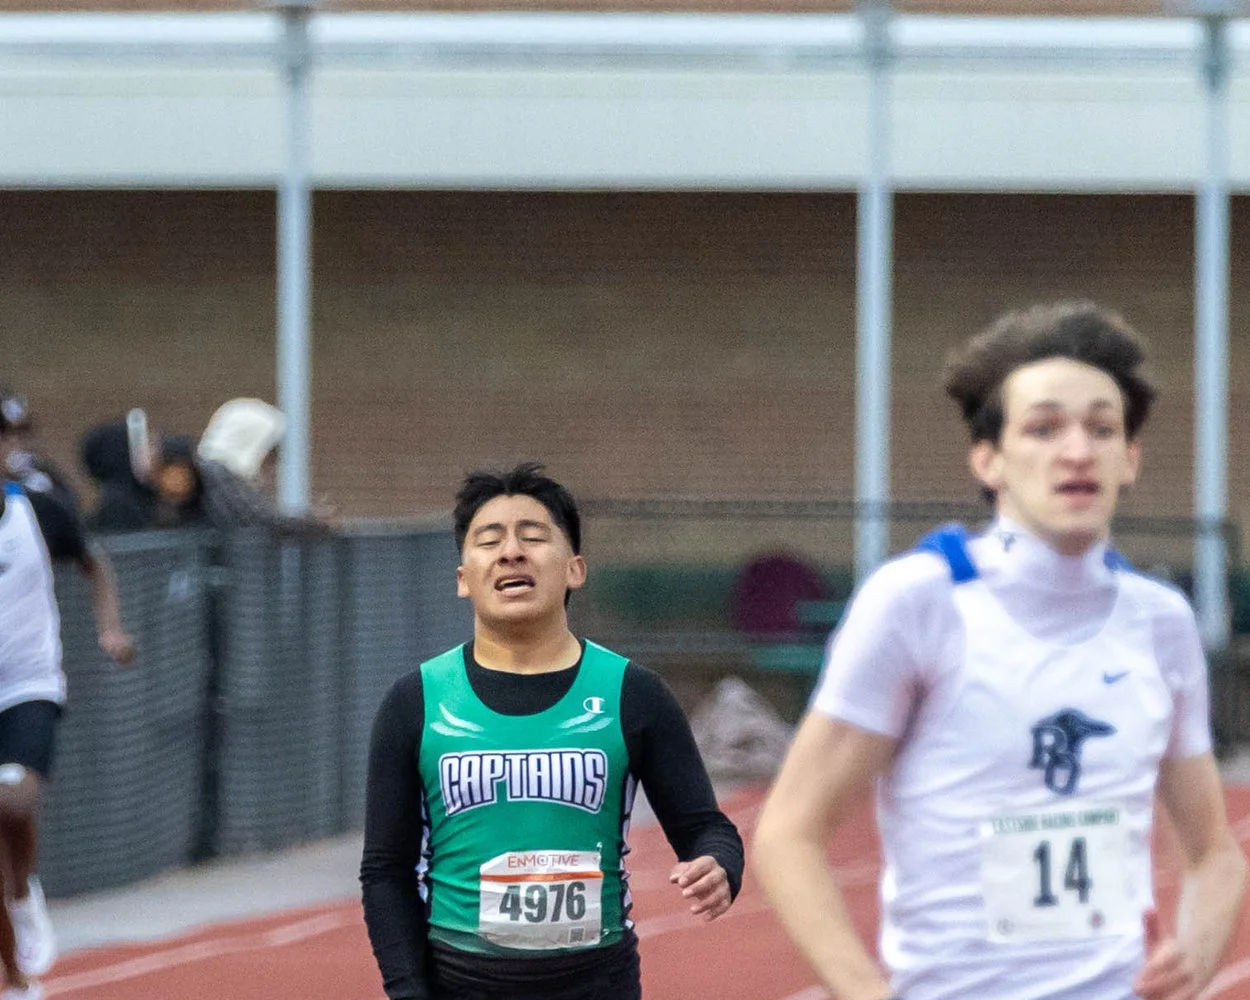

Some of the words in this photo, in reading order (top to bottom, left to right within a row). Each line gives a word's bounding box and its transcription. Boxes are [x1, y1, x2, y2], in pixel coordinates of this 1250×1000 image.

[439, 748, 608, 816] CAPTAINS
[498, 882, 586, 923] 4976
[1033, 837, 1094, 907] 14
